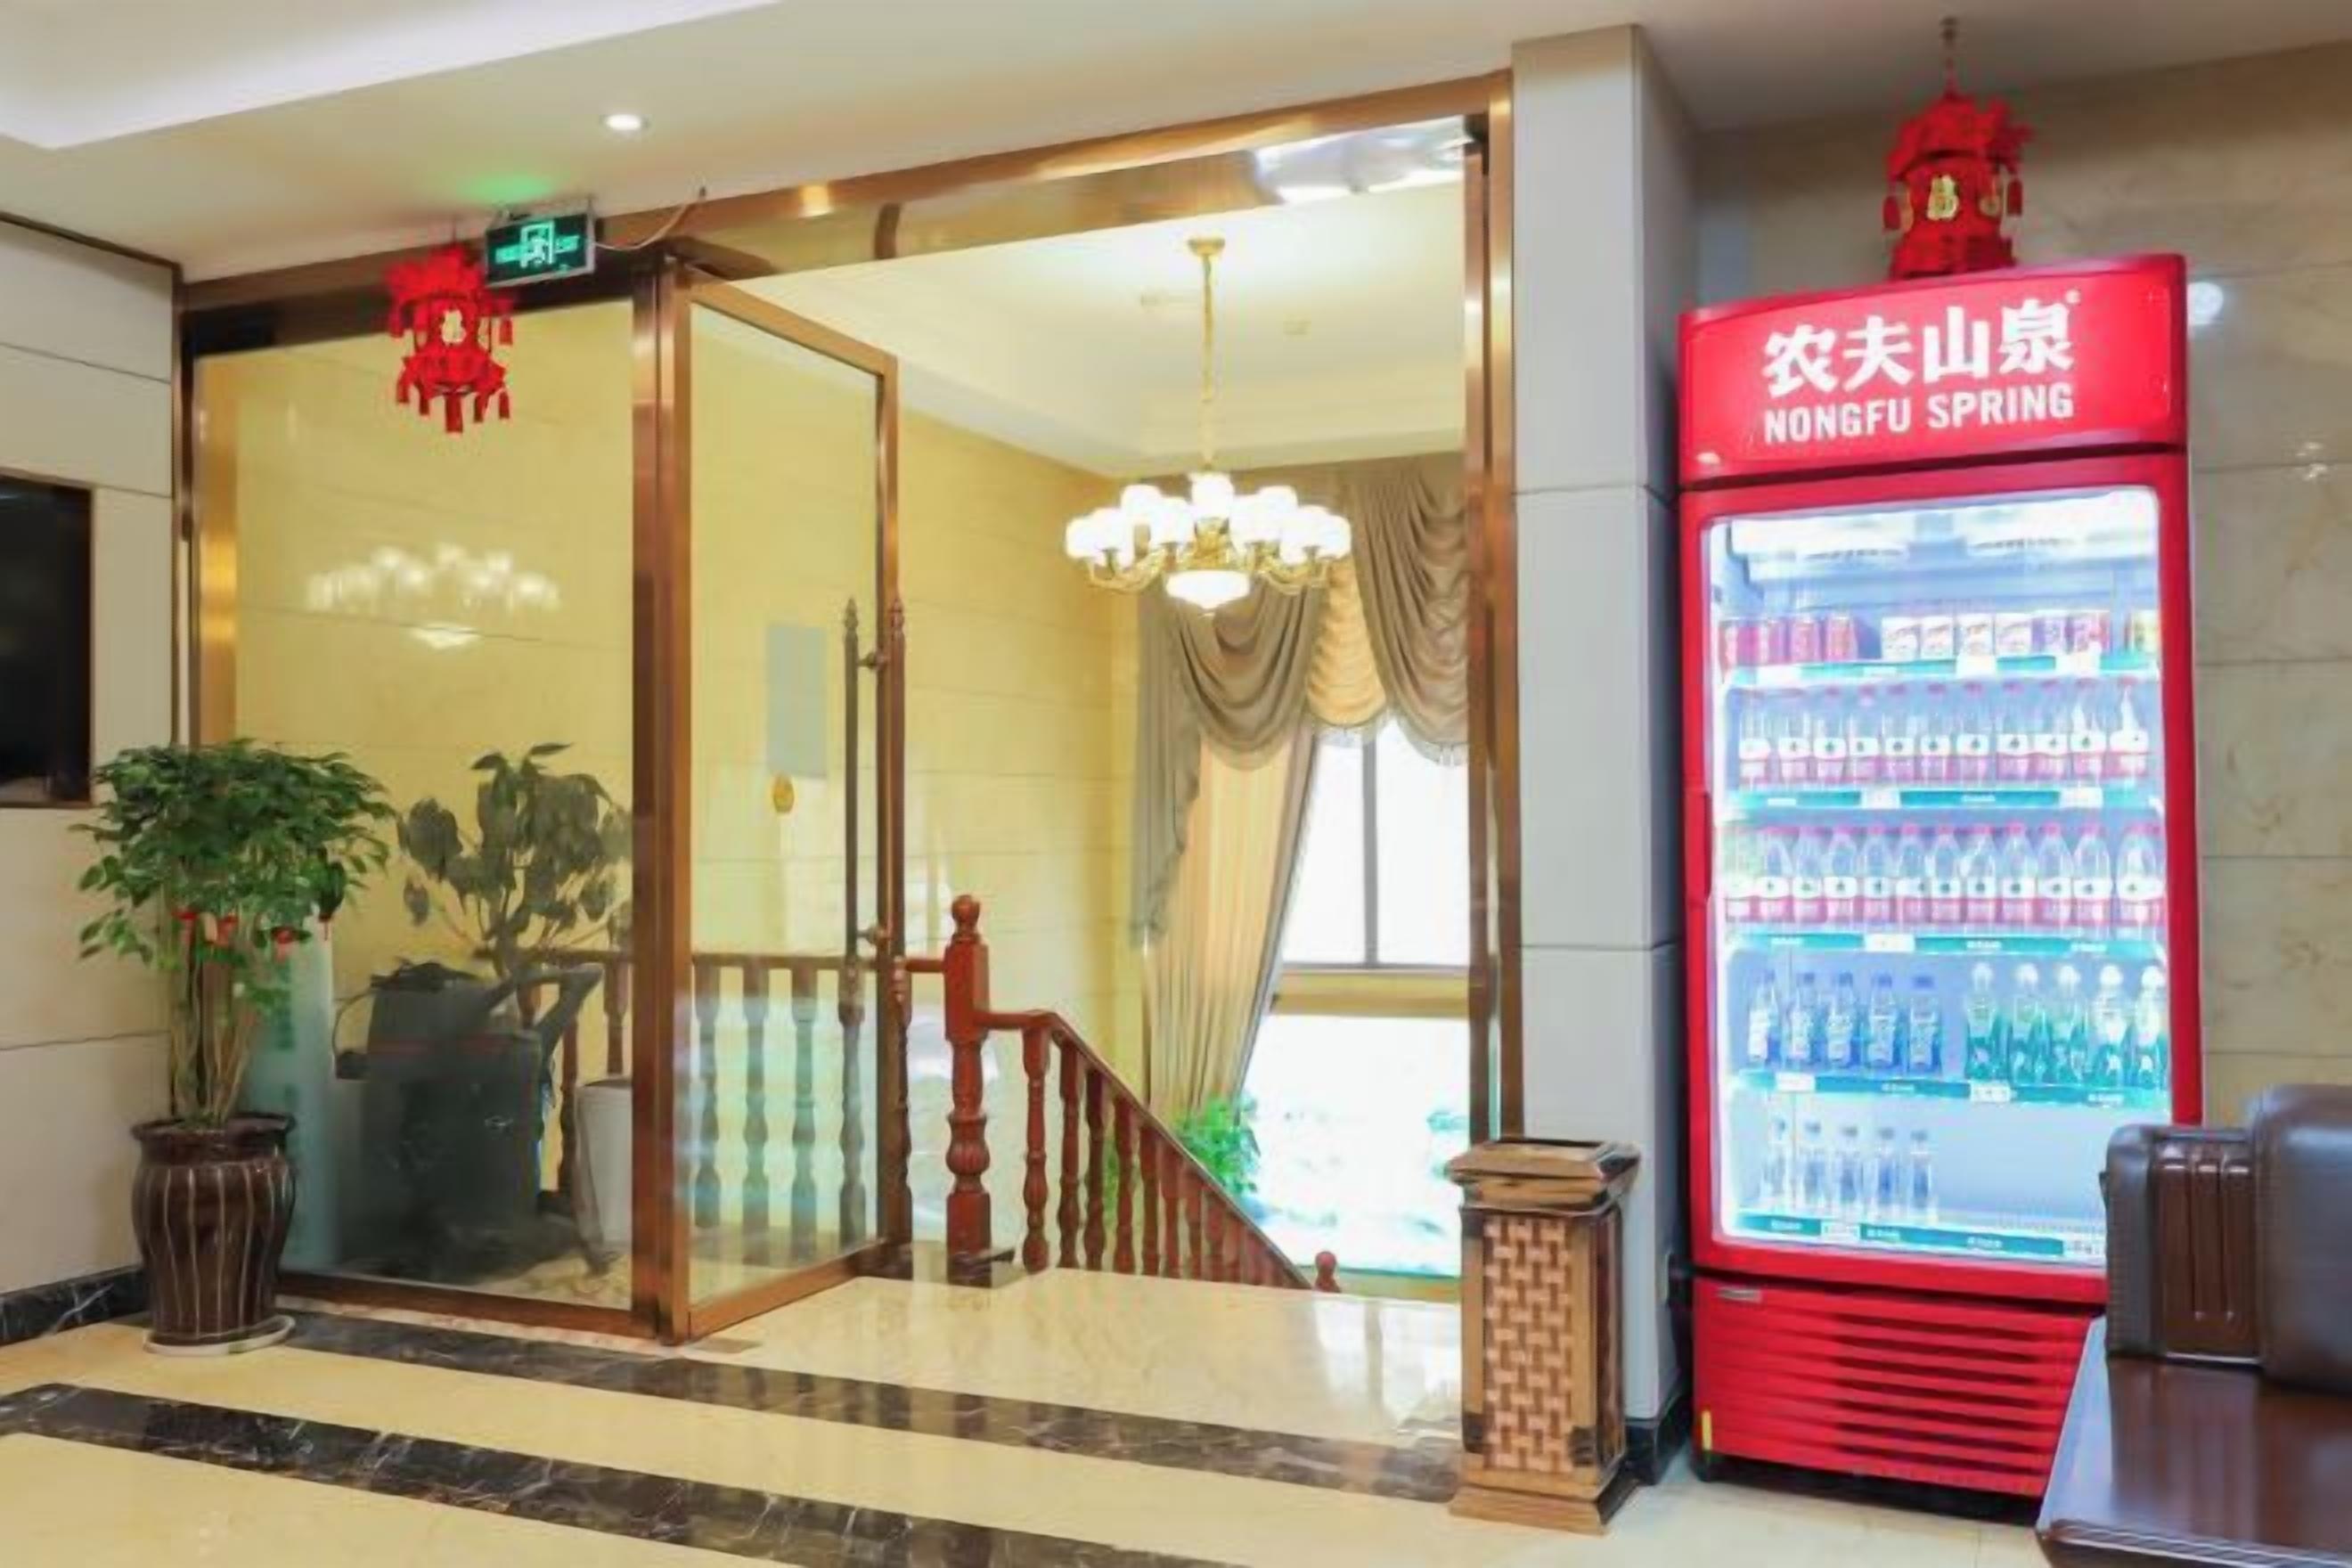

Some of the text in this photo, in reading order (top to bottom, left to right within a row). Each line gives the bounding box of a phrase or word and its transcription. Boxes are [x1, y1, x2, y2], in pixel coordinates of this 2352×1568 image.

[1761, 298, 2075, 400] 农夫山泉
[1764, 381, 2074, 444] NONGFU SPRING
